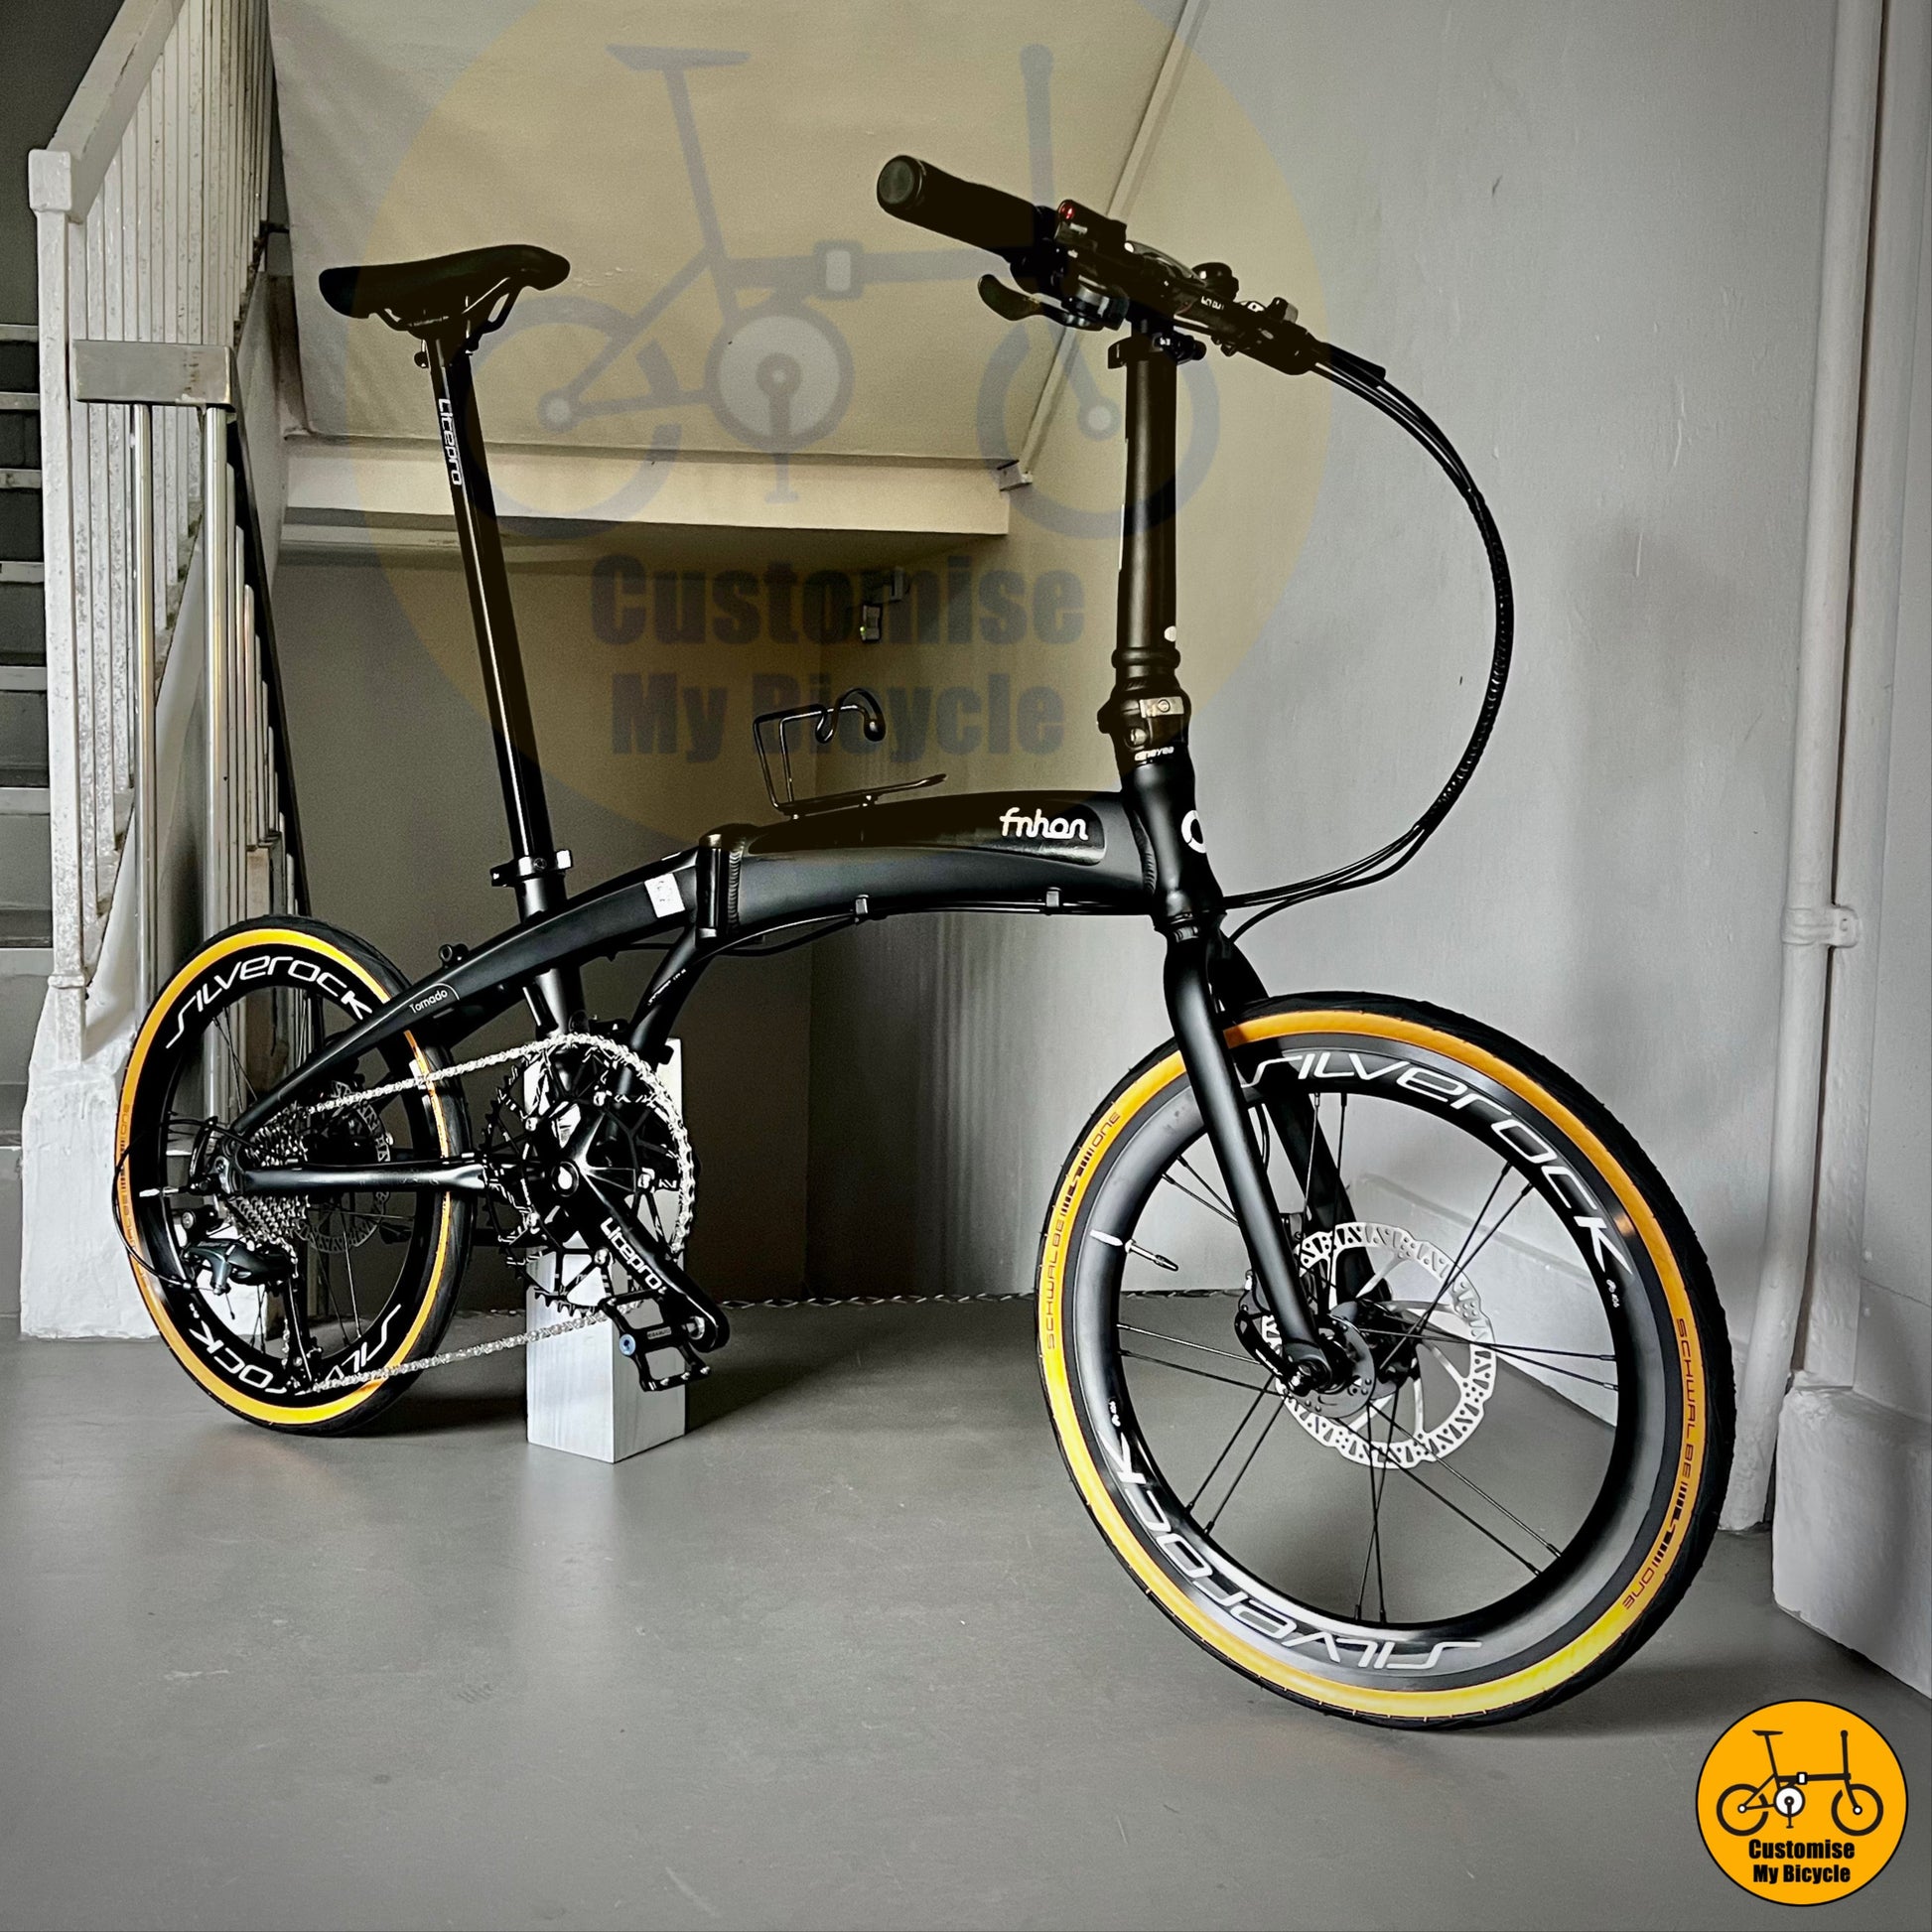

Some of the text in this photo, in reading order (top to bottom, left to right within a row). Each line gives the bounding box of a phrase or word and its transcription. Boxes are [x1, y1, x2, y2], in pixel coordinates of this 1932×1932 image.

[409, 990, 448, 1014] Tornado
[1045, 1219, 1066, 1350] SCHWALBE
[1675, 1317, 1697, 1478] SCHWALBE
